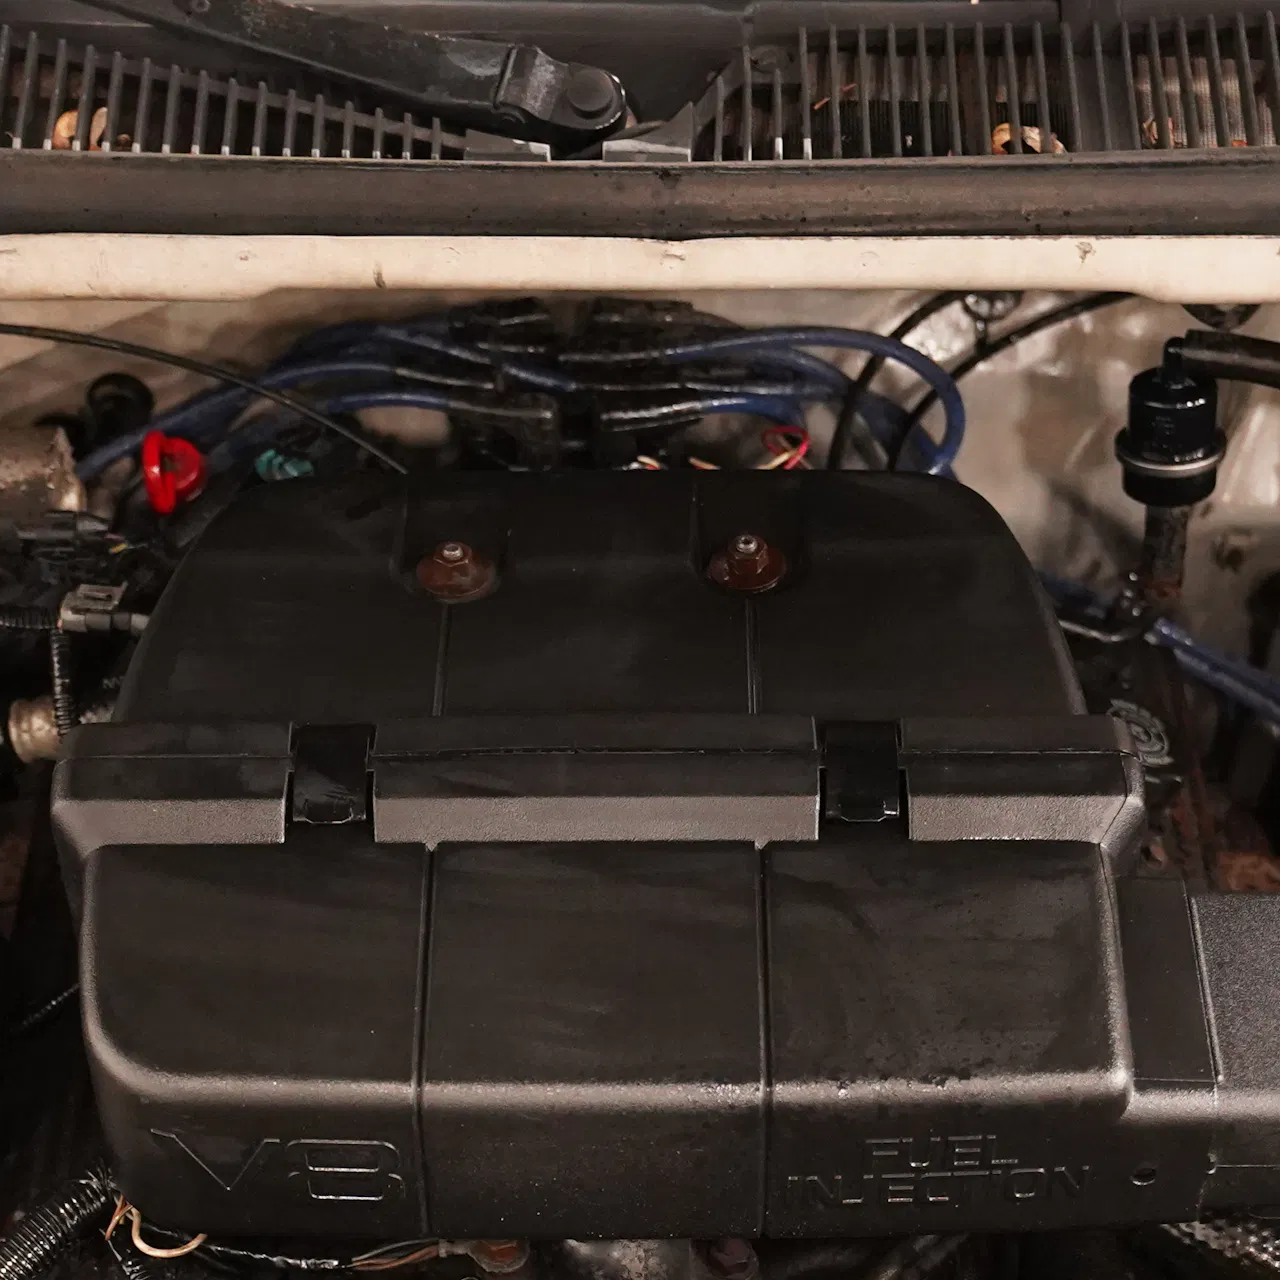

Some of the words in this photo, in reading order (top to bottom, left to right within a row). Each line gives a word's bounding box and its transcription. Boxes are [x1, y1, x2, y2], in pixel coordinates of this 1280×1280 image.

[151, 1129, 406, 1205] V8
[866, 1135, 1018, 1166] FUEL
[786, 1165, 1092, 1204] INJECTION
